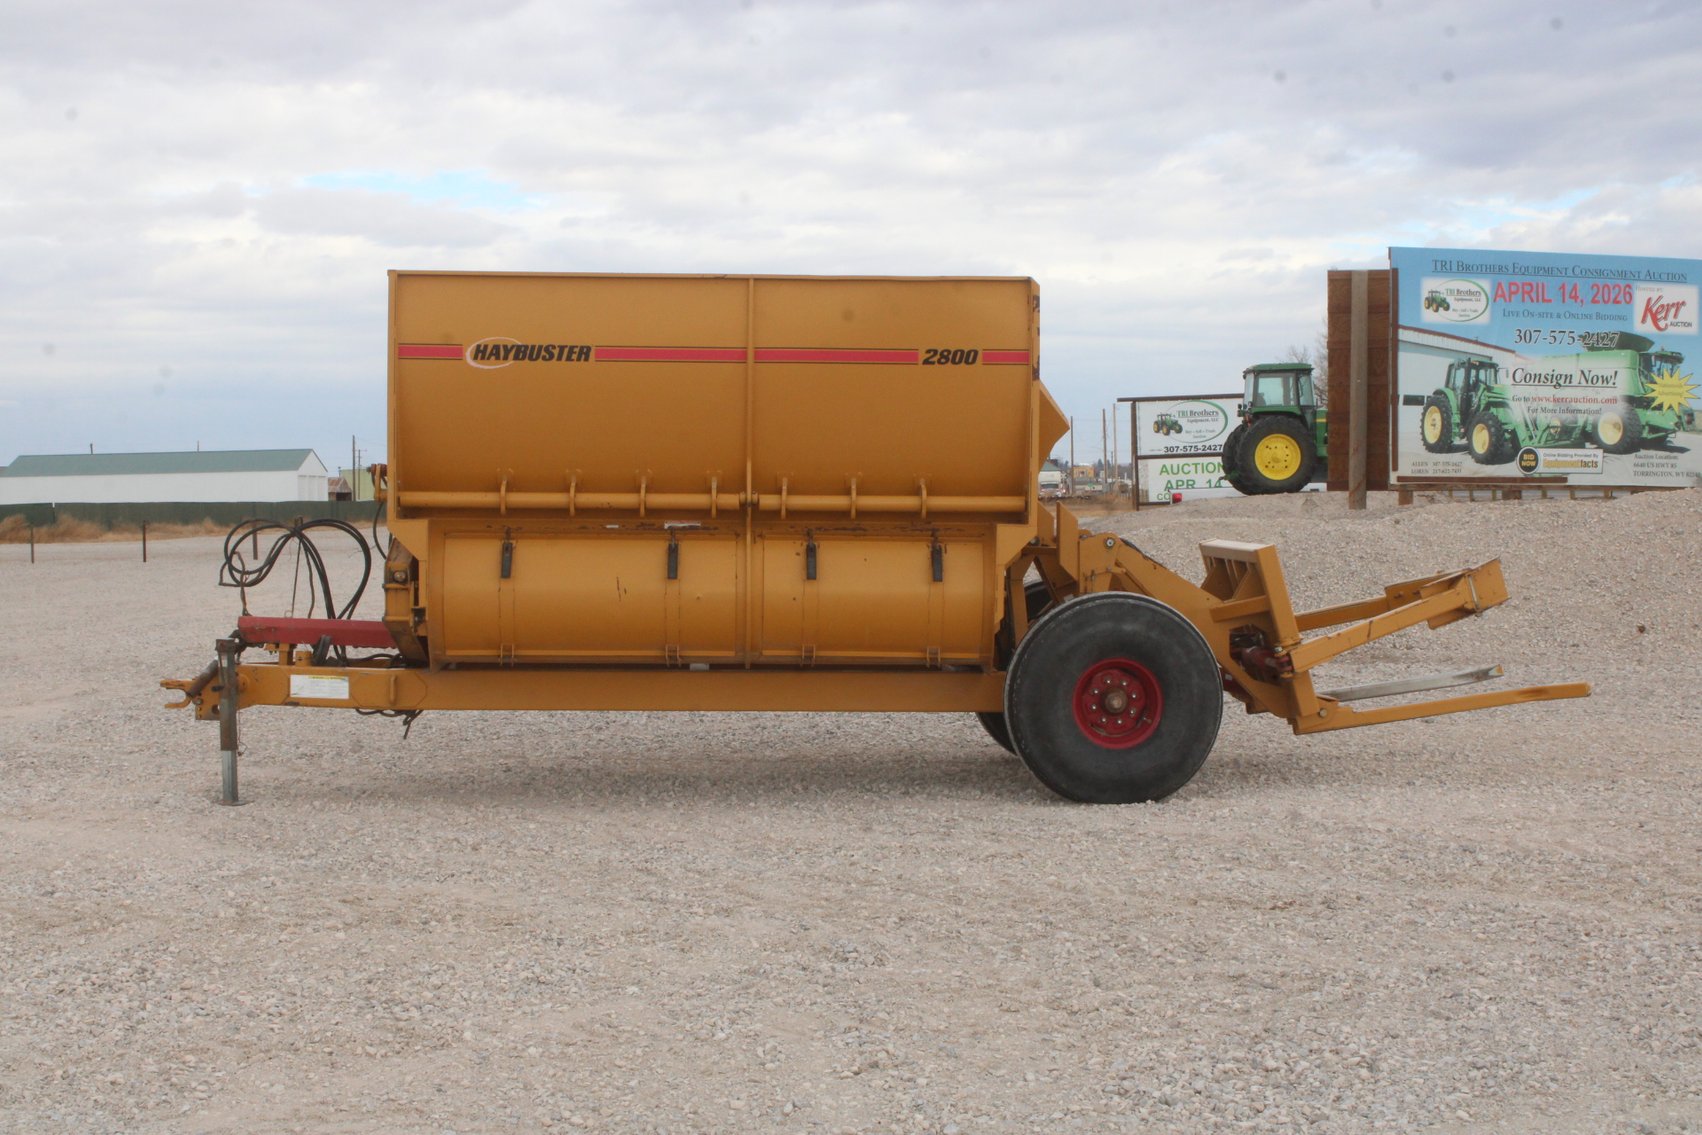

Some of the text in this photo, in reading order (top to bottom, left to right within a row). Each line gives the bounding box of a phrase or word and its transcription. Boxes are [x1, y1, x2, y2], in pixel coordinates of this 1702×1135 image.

[1432, 259, 1453, 272] TRI
[1456, 288, 1482, 297] Brothers
[1493, 282, 1634, 307] APRIL 14, 2026
[1641, 294, 1687, 332] Kerr
[1514, 328, 1620, 348] 307-575-2427
[473, 344, 592, 362] HAYBUSTER
[922, 348, 979, 366] 2800
[1511, 367, 1618, 389] Consign Now!
[1523, 395, 1531, 403] to
[1531, 394, 1618, 405] www.kerrauction.com
[1189, 409, 1219, 417] Brothers
[1527, 406, 1602, 415] For More Information!
[1163, 444, 1223, 454] 307-575-2427
[1521, 460, 1537, 468] NOW
[1164, 479, 1223, 491] APR 14
